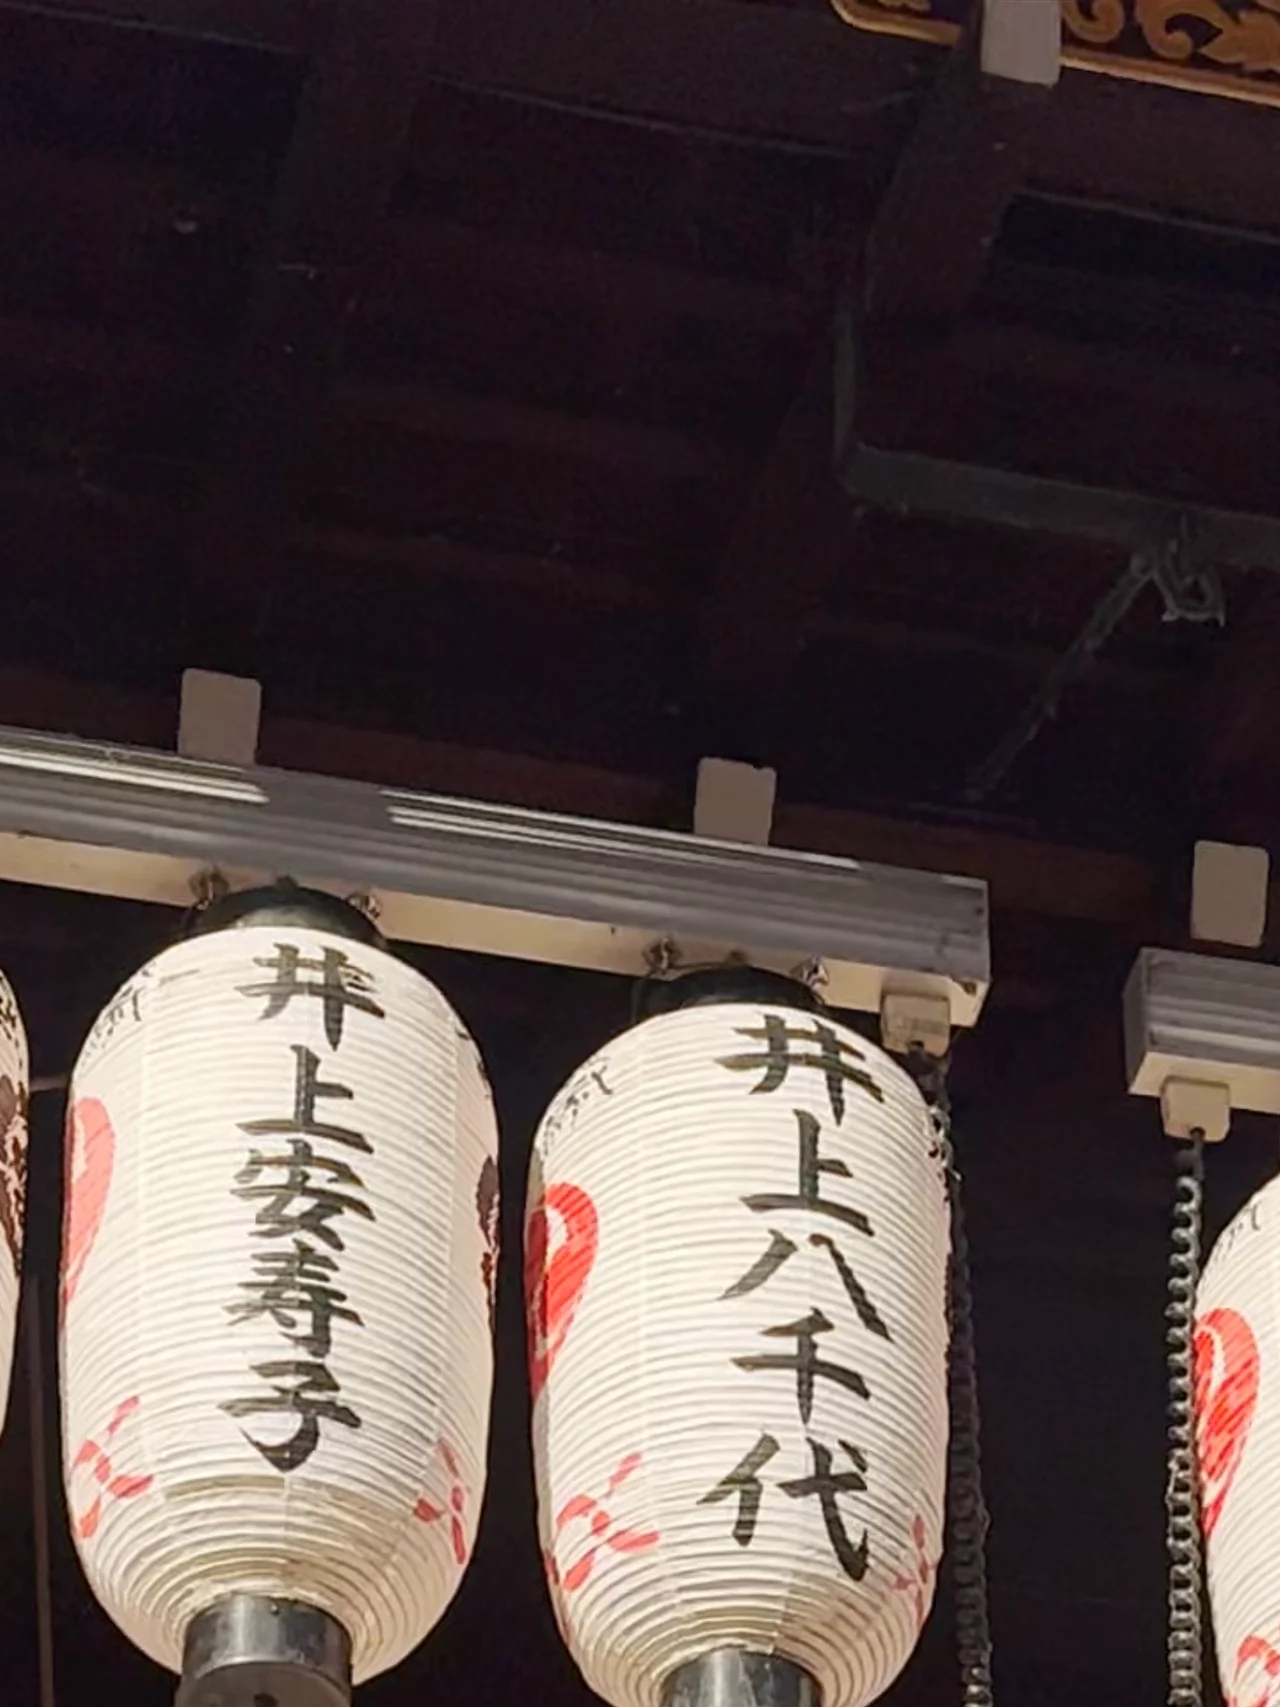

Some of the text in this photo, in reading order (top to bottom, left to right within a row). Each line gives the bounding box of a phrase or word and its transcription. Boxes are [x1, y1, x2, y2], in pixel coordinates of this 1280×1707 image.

[217, 943, 386, 1472] 井上安寿子
[695, 1014, 889, 1581] 井上八千代
